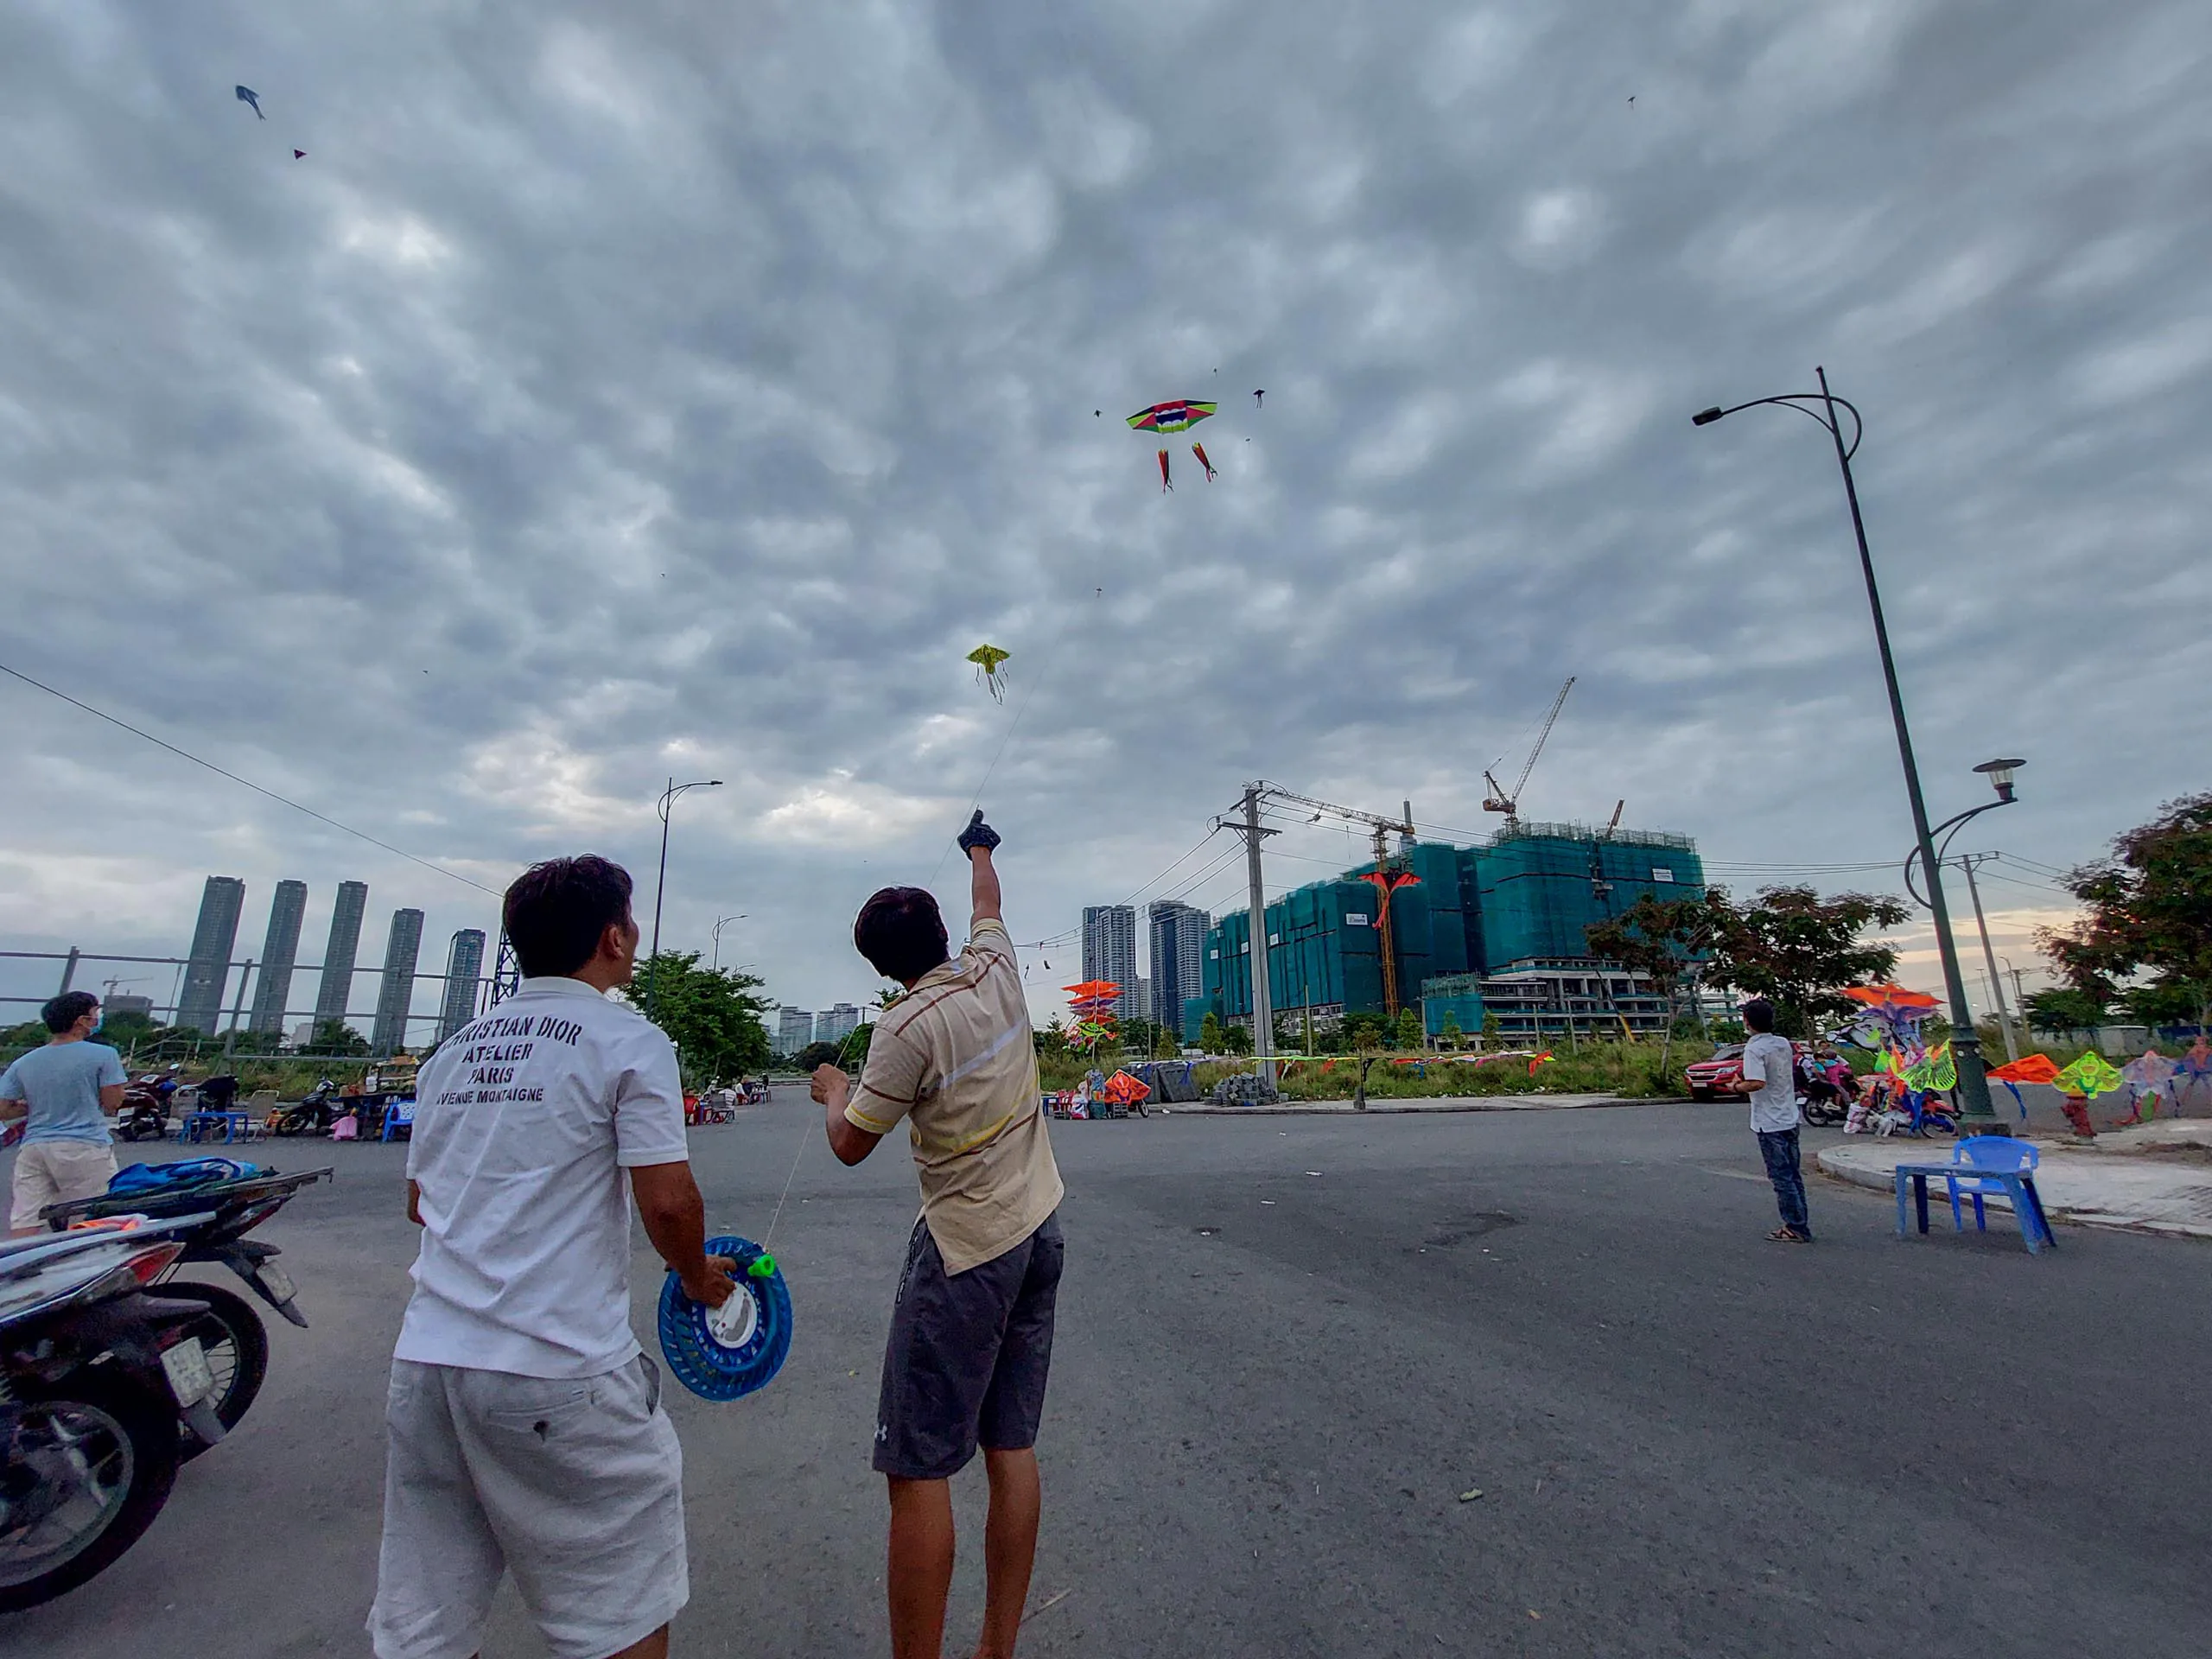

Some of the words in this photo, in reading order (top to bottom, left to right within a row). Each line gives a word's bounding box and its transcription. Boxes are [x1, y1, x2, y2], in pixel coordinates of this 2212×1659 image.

[537, 1016, 582, 1046] DIOR
[461, 1043, 533, 1064] ATELIER
[467, 1066, 514, 1084] PARIS
[476, 1088, 544, 1103] MONTAIGNE
